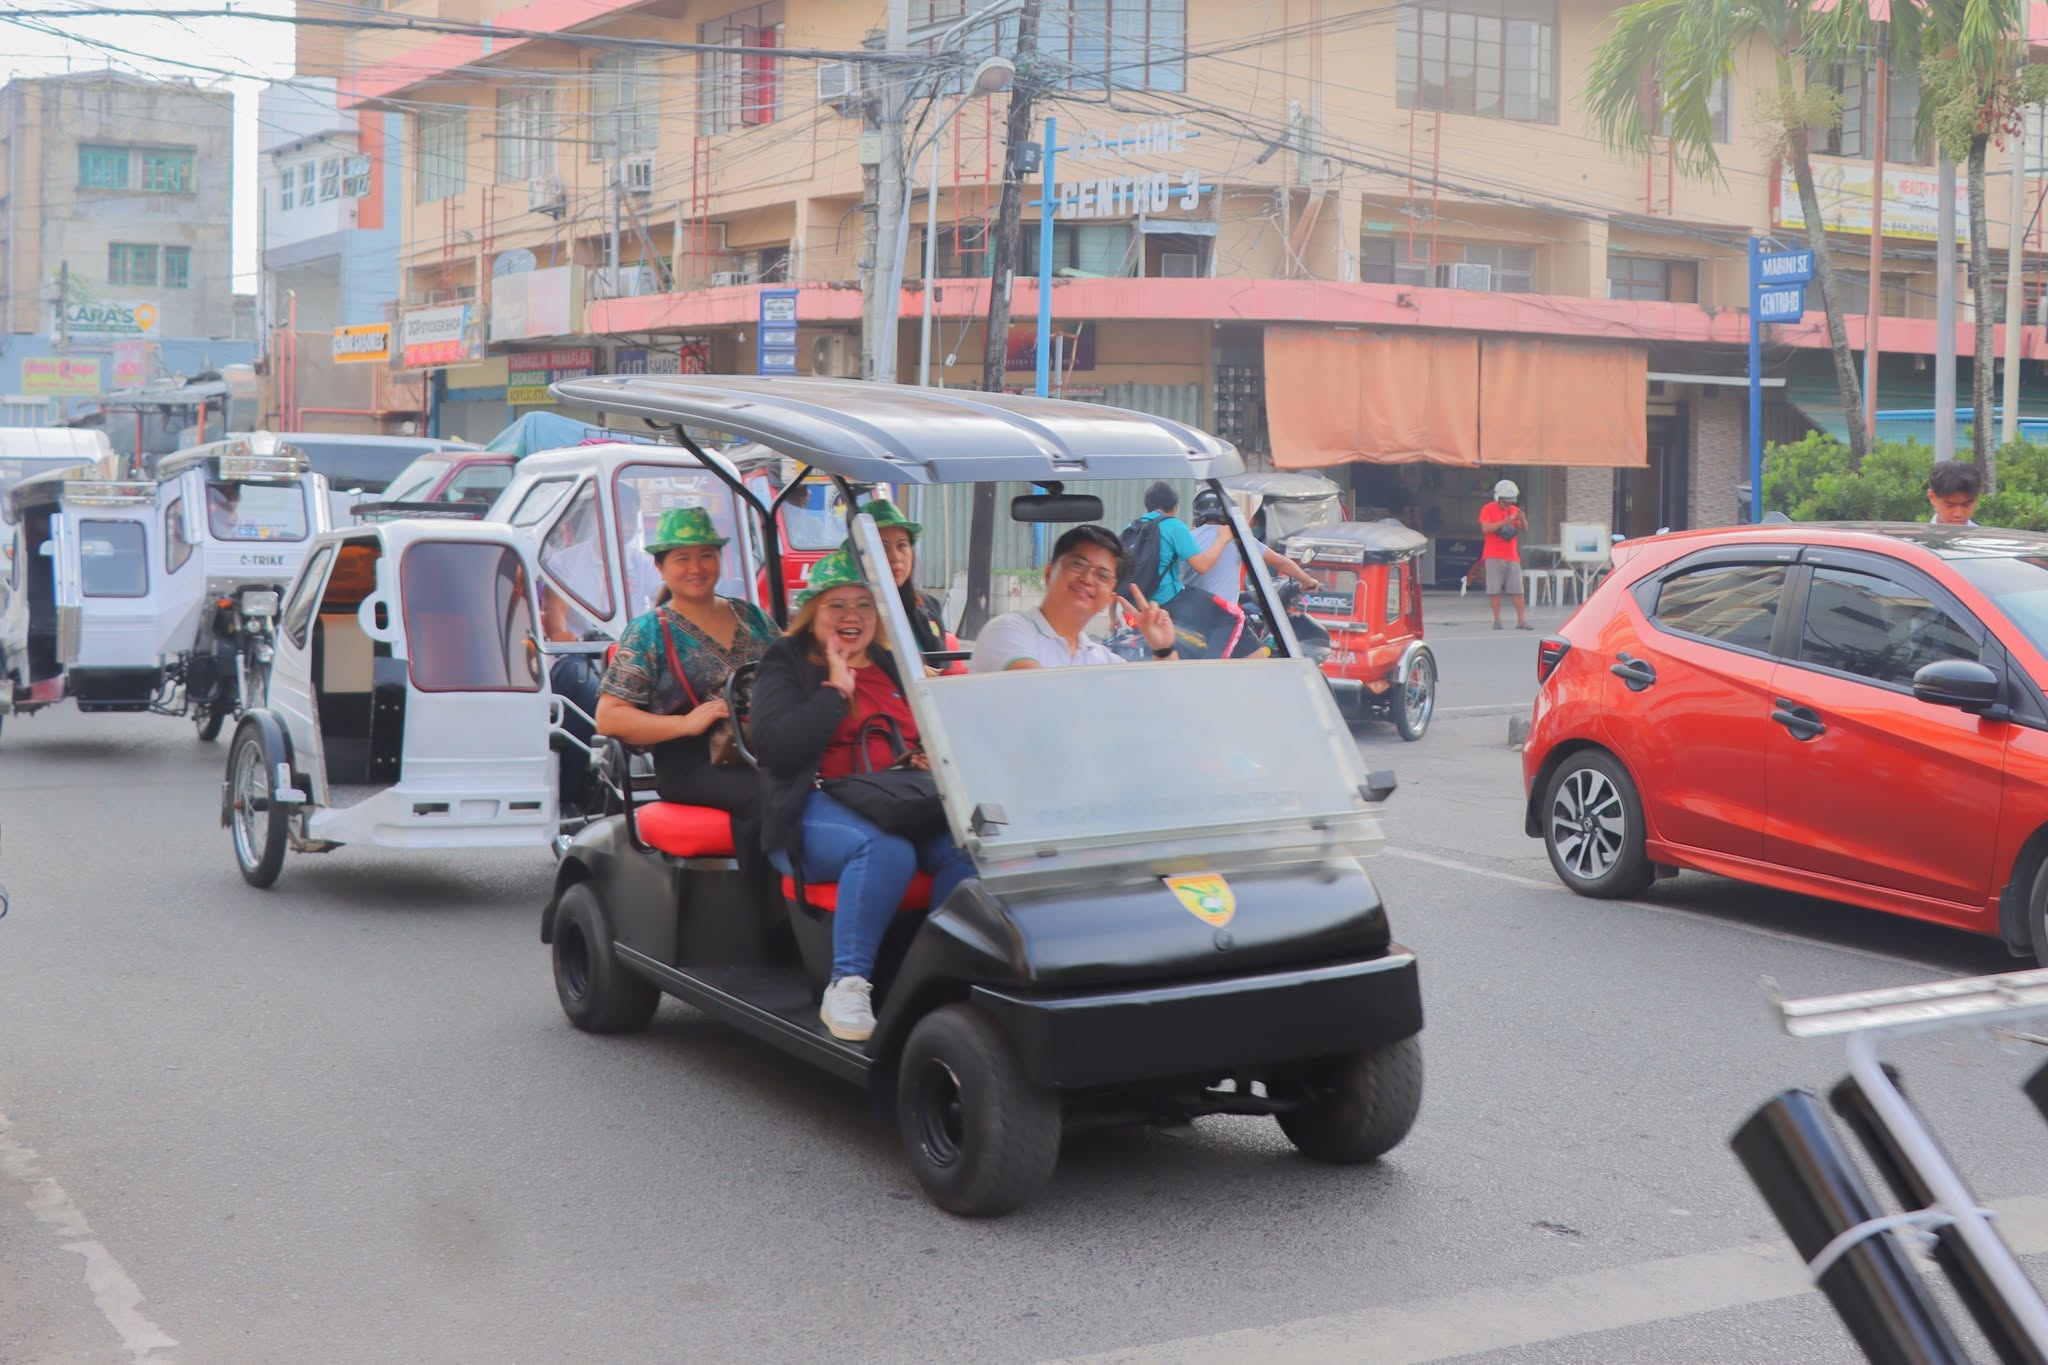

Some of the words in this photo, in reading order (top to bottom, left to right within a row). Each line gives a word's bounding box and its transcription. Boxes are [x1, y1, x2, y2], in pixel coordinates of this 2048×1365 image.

[1068, 117, 1186, 162] WELCOME
[1060, 172, 1169, 219] CENTRO
[1180, 170, 1200, 210] 3
[1762, 255, 1797, 277] MABINI
[619, 359, 643, 374] CUT
[650, 357, 679, 374] SHAVE
[511, 371, 546, 386] SIGNAGES
[240, 555, 285, 566] C-TRIKE
